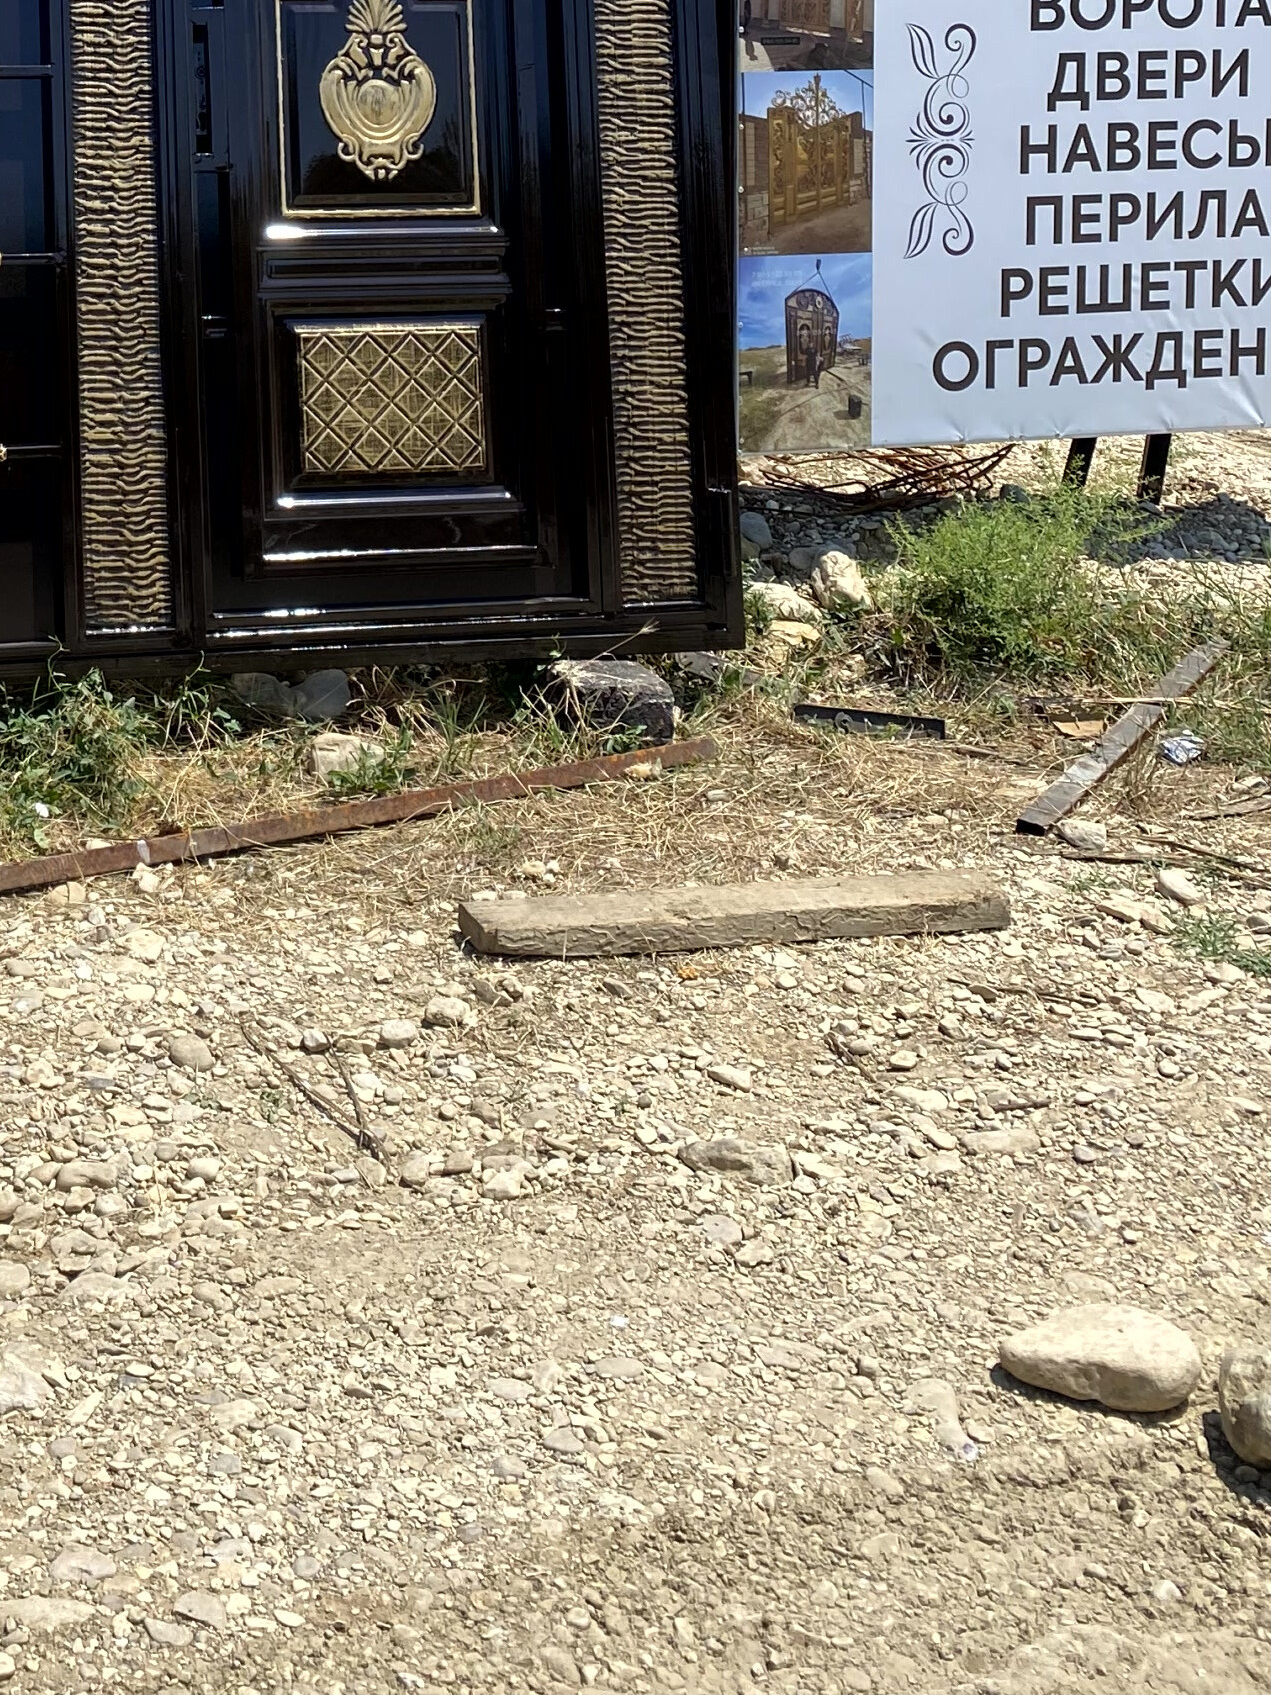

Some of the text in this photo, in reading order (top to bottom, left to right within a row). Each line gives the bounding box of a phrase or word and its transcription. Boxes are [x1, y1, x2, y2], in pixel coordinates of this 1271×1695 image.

[1047, 48, 1250, 112] ДВЕРИ
[1020, 118, 1271, 174] НАВЕСЫ
[1026, 188, 1270, 245] ПЕРИЛА
[933, 327, 1266, 392] ОГРАЖДЕН
